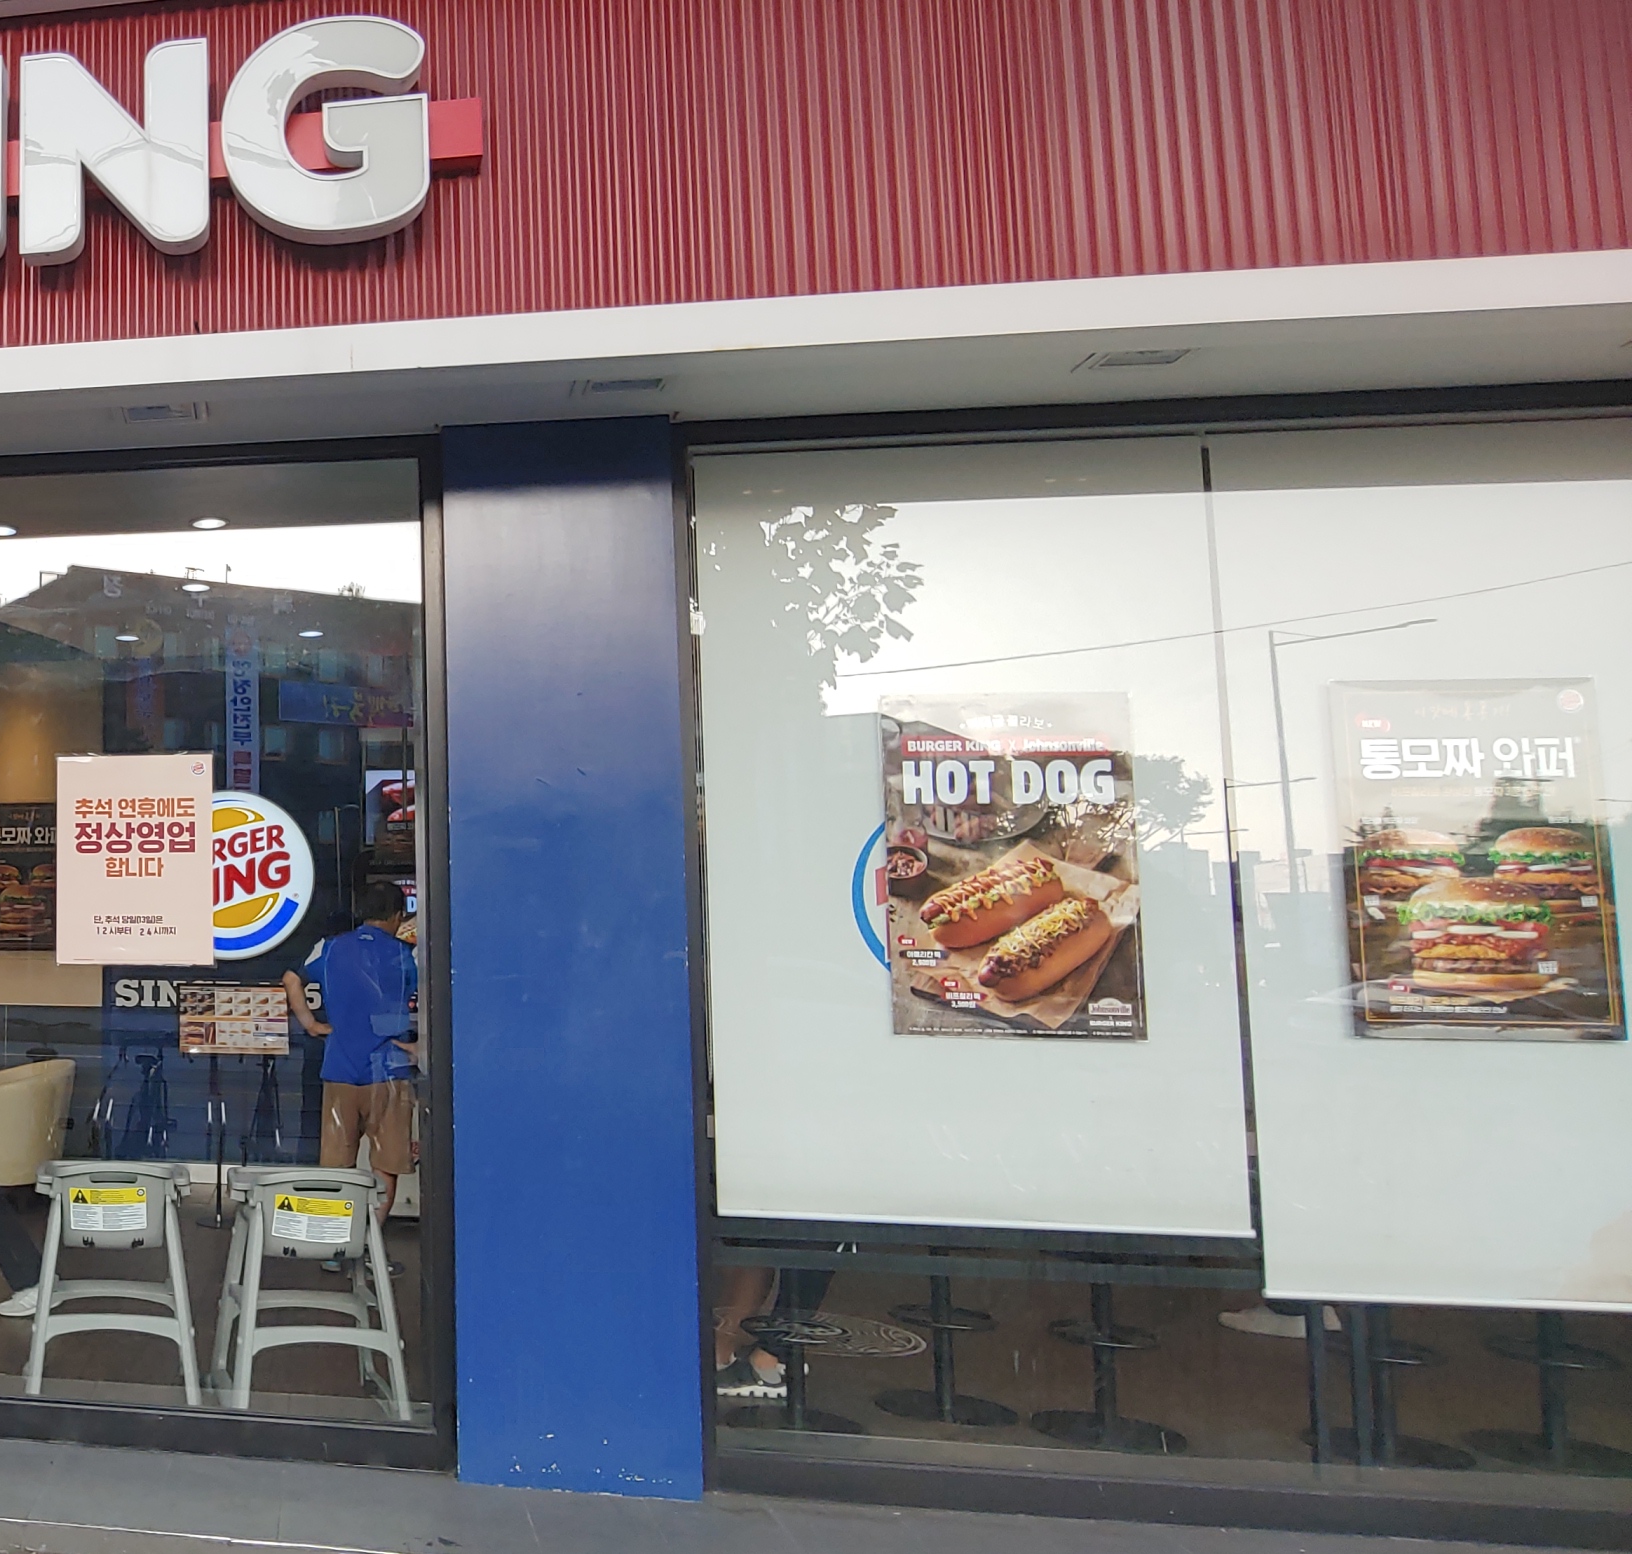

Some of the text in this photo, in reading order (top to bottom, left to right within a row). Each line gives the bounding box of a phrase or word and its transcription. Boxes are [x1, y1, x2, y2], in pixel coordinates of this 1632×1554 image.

[907, 740, 963, 753] BURGER
[965, 740, 1001, 753] KING
[1022, 737, 1106, 754] Johnsonville
[1359, 736, 1577, 780] 통모짜 와퍼
[901, 759, 1115, 805] HOT DOG
[74, 797, 196, 819] 추석 연휴에도
[74, 822, 196, 854] 정상영업
[212, 824, 285, 866] RGER
[105, 857, 164, 878] 합니다
[212, 851, 291, 908] ING
[104, 915, 120, 925] 추석
